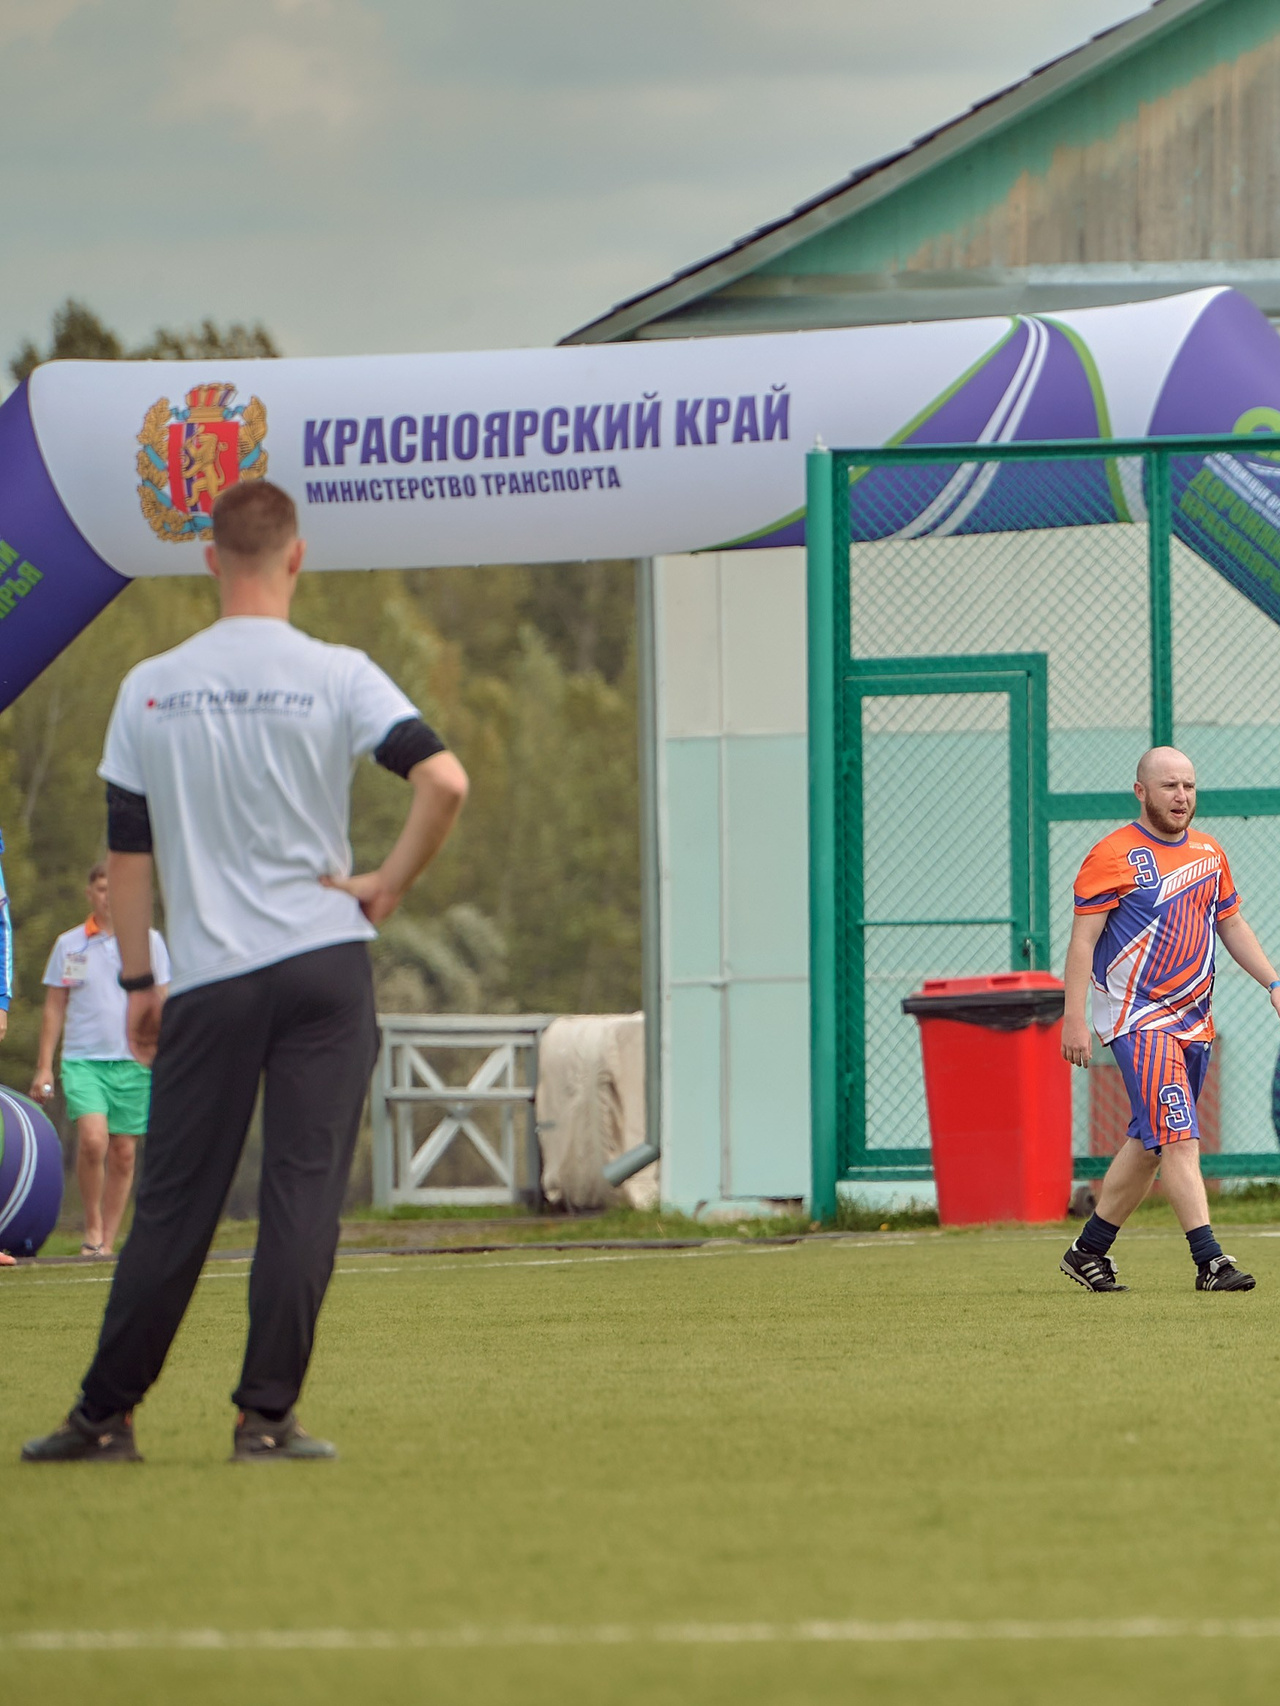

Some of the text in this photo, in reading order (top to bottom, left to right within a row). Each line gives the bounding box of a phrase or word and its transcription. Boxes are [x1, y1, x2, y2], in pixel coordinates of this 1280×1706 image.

[303, 384, 791, 467] КРАСНОЯРСКИЙ КРАЙ
[305, 466, 623, 505] МИНИСТЕРСТВО ТРАНСПОРТА
[1127, 846, 1161, 890] 3
[1158, 1084, 1193, 1132] 3
